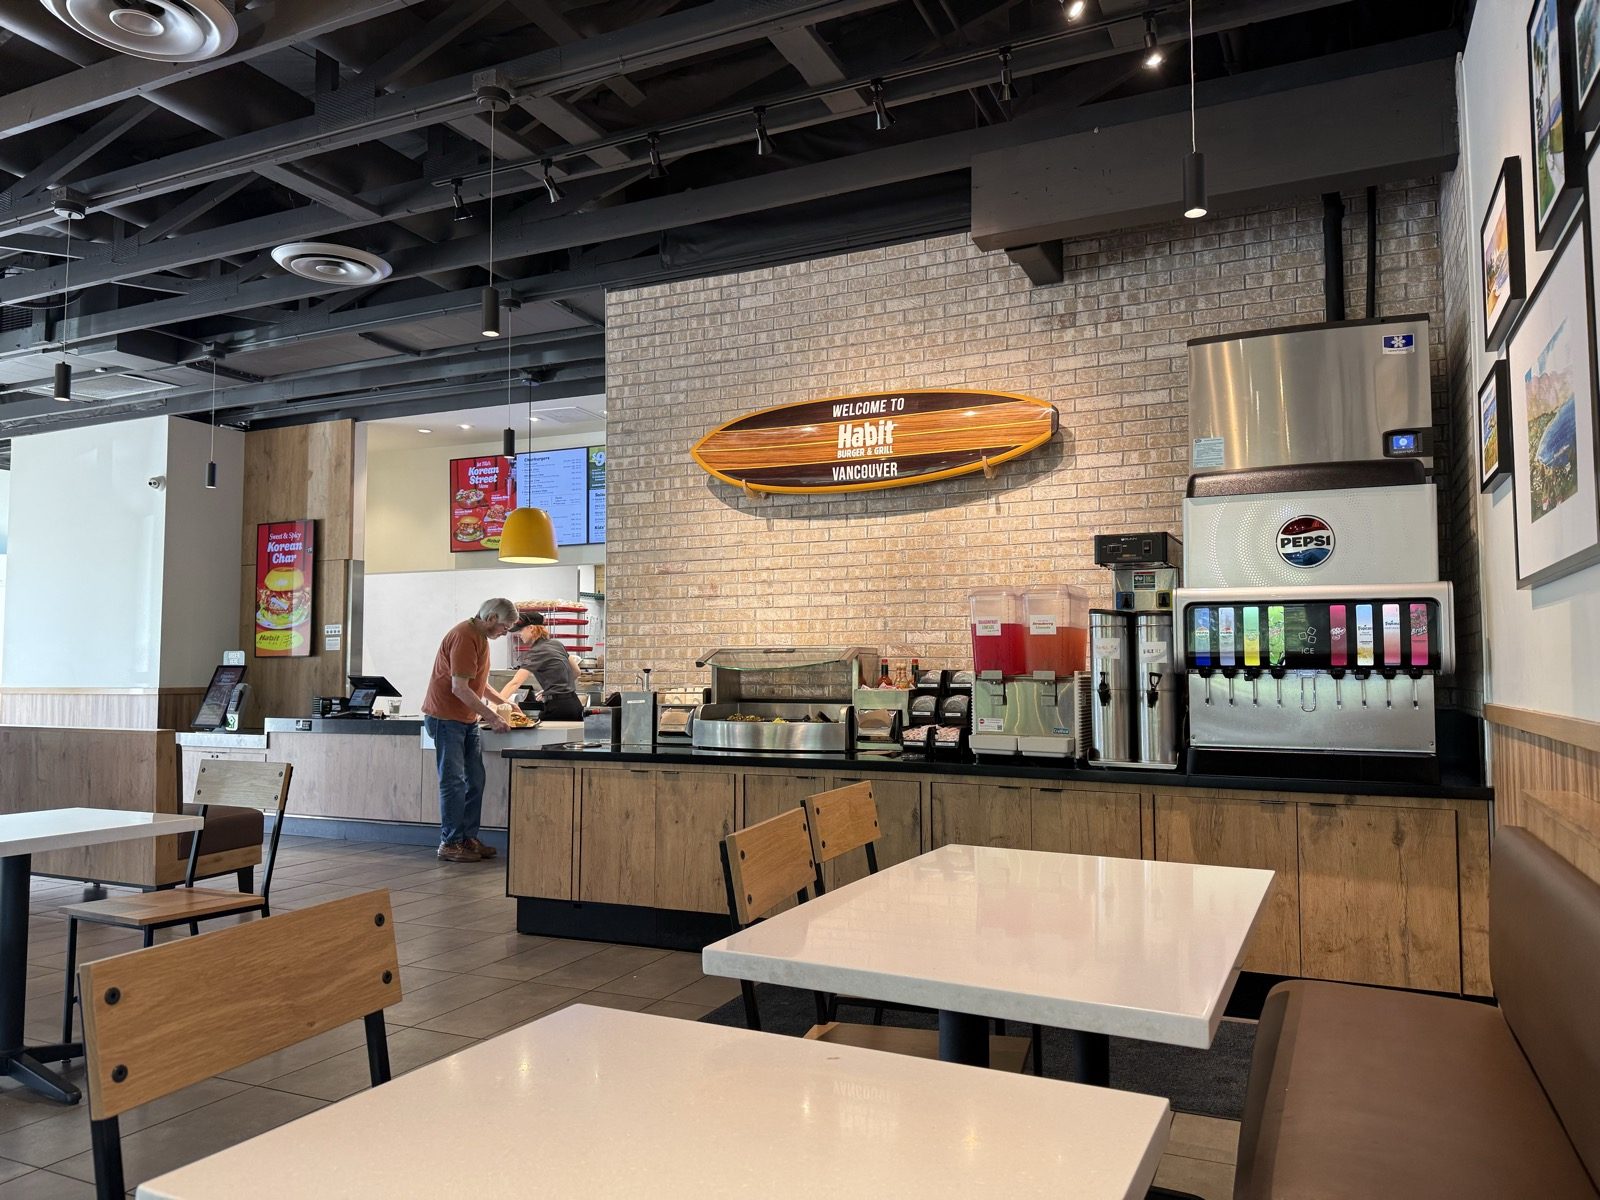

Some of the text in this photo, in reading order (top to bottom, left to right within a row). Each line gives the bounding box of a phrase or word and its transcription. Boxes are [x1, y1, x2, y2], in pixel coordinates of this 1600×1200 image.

[833, 397, 905, 418] WELCOME TO
[837, 420, 895, 449] Habit
[837, 445, 894, 458] BURGER & GRILL
[468, 467, 499, 476] Korean
[832, 462, 898, 481] VANCOUVER
[469, 474, 498, 485] Street
[289, 531, 302, 541] Spicy
[267, 541, 303, 552] Korean
[1280, 535, 1331, 549] PEPSI
[272, 553, 297, 564] Char
[1411, 625, 1428, 636] Brisk
[1301, 647, 1315, 655] ICE
